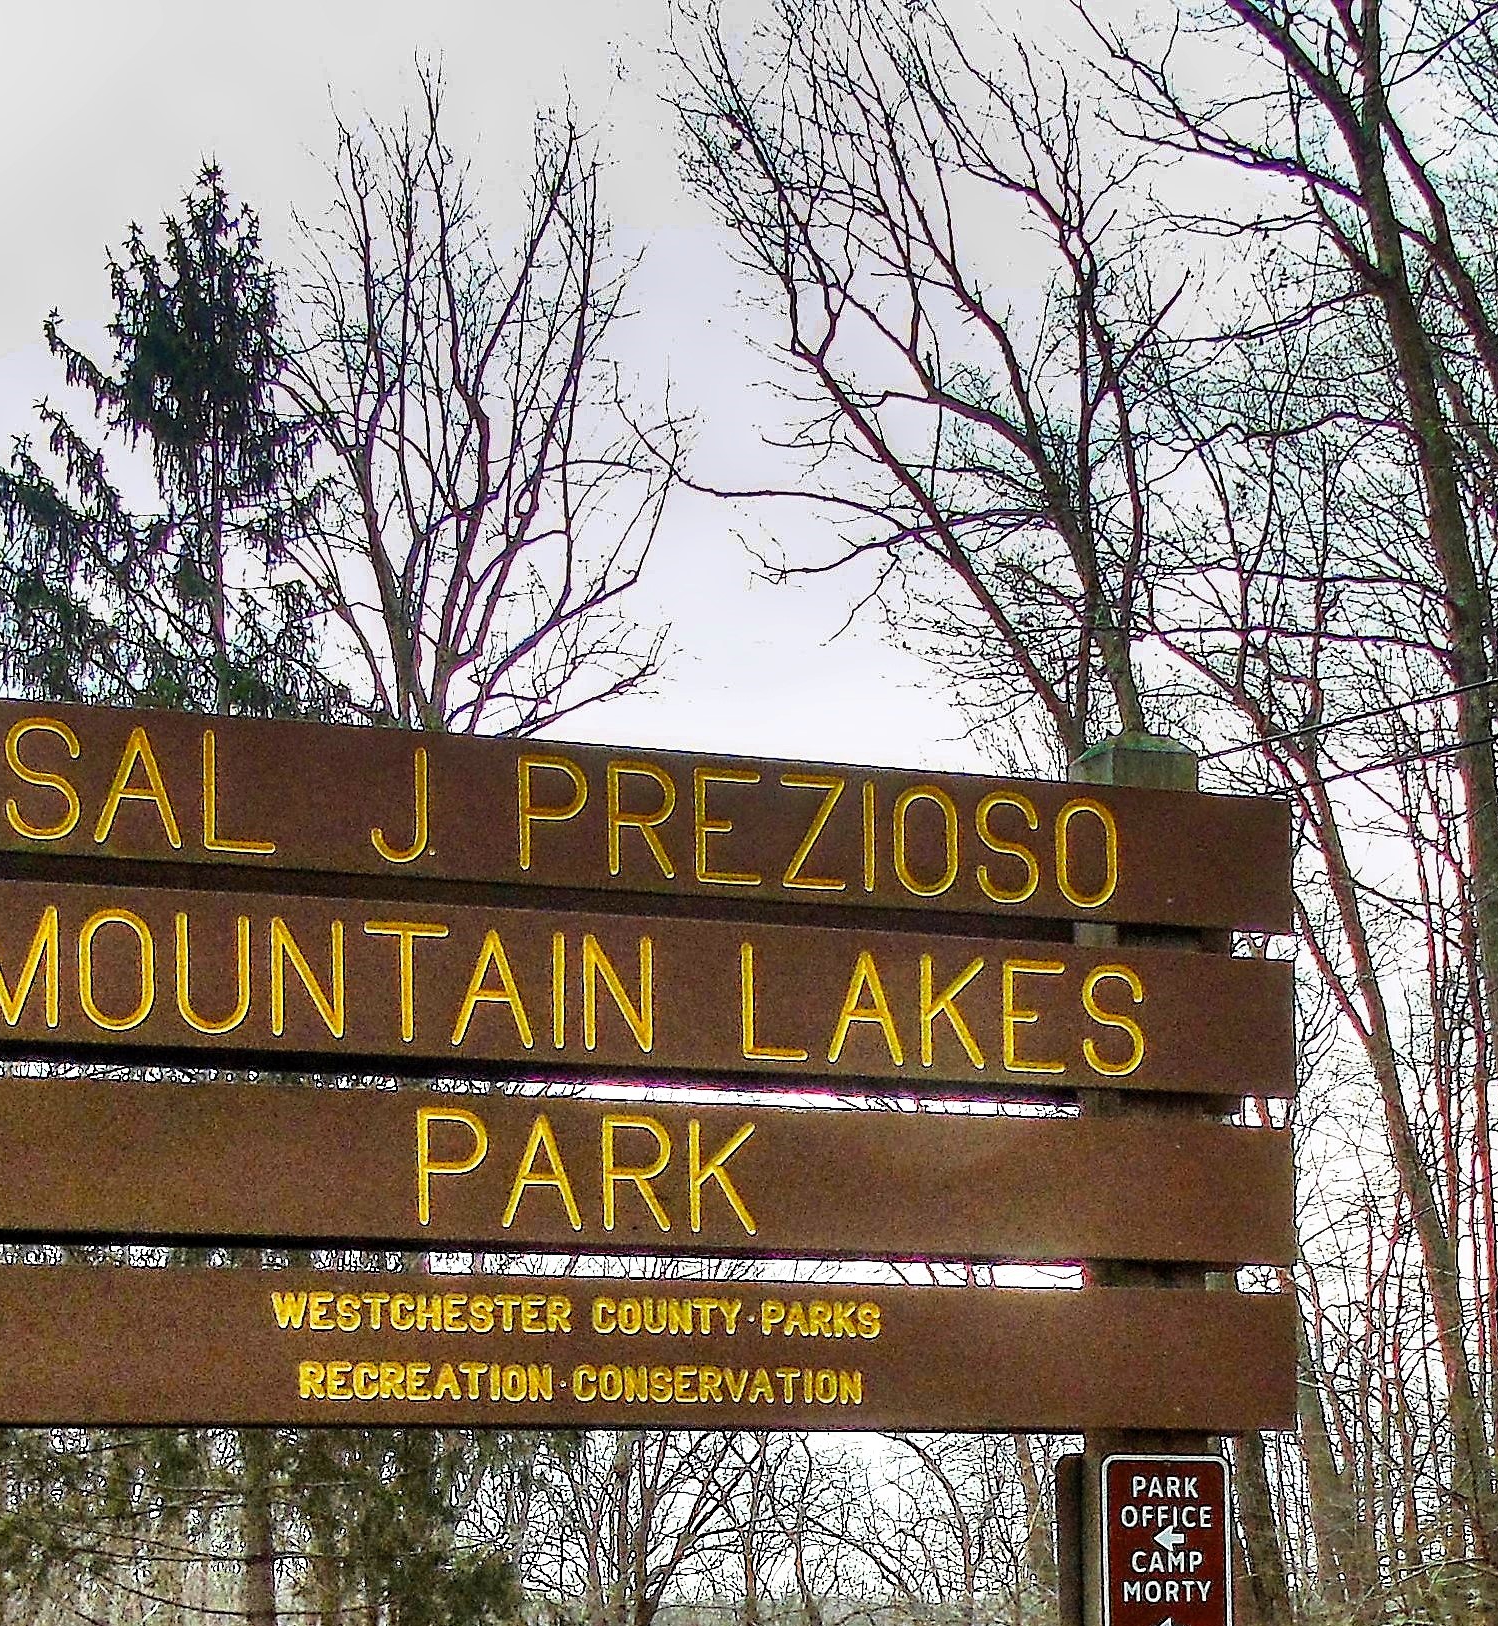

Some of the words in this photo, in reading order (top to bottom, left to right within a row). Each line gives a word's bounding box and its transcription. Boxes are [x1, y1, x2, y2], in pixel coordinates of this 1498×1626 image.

[4, 716, 276, 854] SAL
[518, 754, 1119, 908] PREZIOSO
[740, 940, 1146, 1075] LAKES
[415, 1105, 758, 1234] PARK
[271, 1290, 573, 1335] WESTCHESTER
[1132, 1475, 1199, 1498] PARK
[1120, 1505, 1212, 1528] OFFICE
[1131, 1551, 1203, 1573] CAMP
[1123, 1580, 1212, 1603] MORTY
